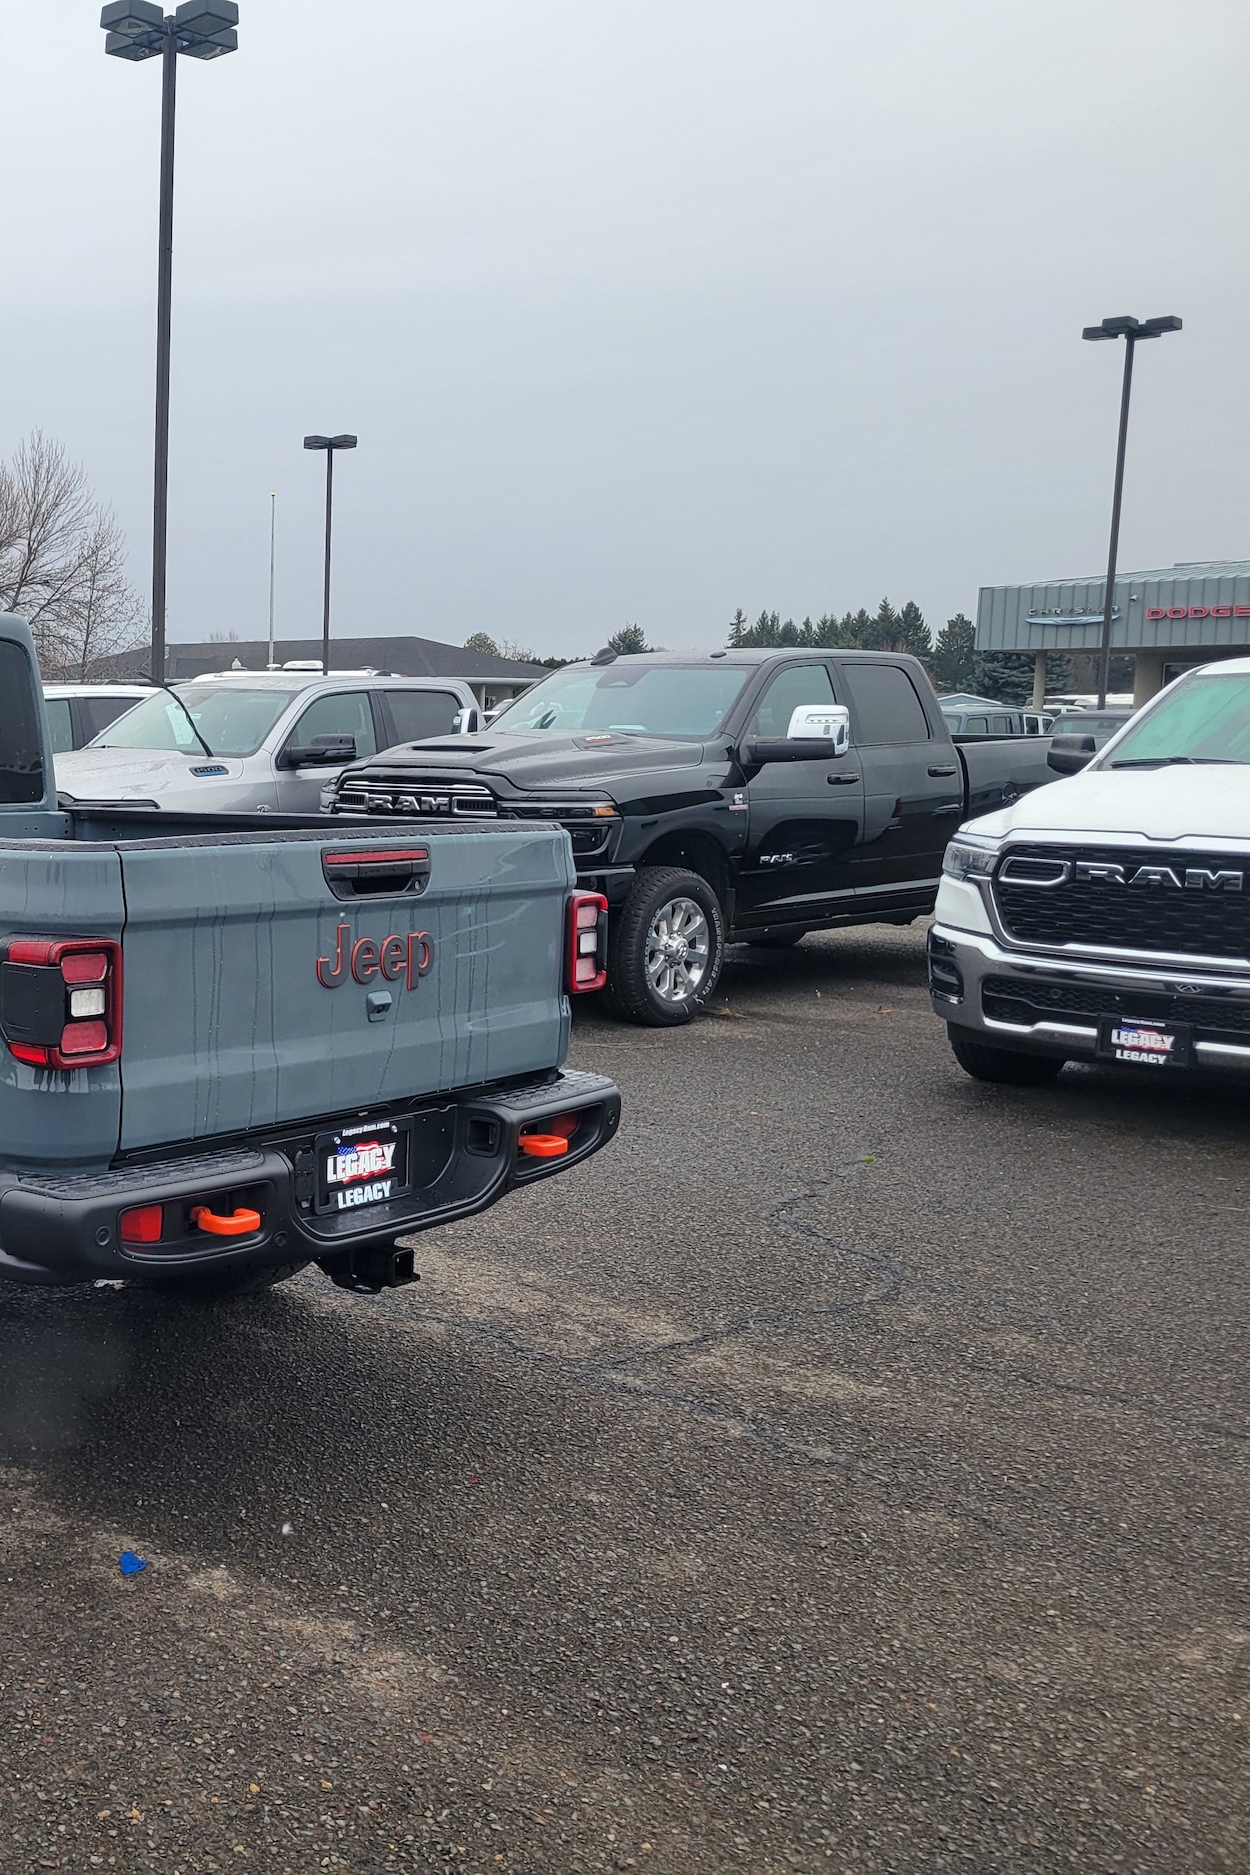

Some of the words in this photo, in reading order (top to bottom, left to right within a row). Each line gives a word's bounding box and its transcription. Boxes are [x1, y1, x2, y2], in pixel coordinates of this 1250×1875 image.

[1145, 604, 1250, 620] DODGE
[368, 794, 450, 811] RAM
[1075, 861, 1244, 891] RAM
[316, 924, 435, 991] Jeep
[1111, 1029, 1175, 1050] LEGACY
[1115, 1049, 1166, 1065] LEGACY
[327, 1143, 395, 1181] LEGACY
[337, 1181, 391, 1209] LEGACY
